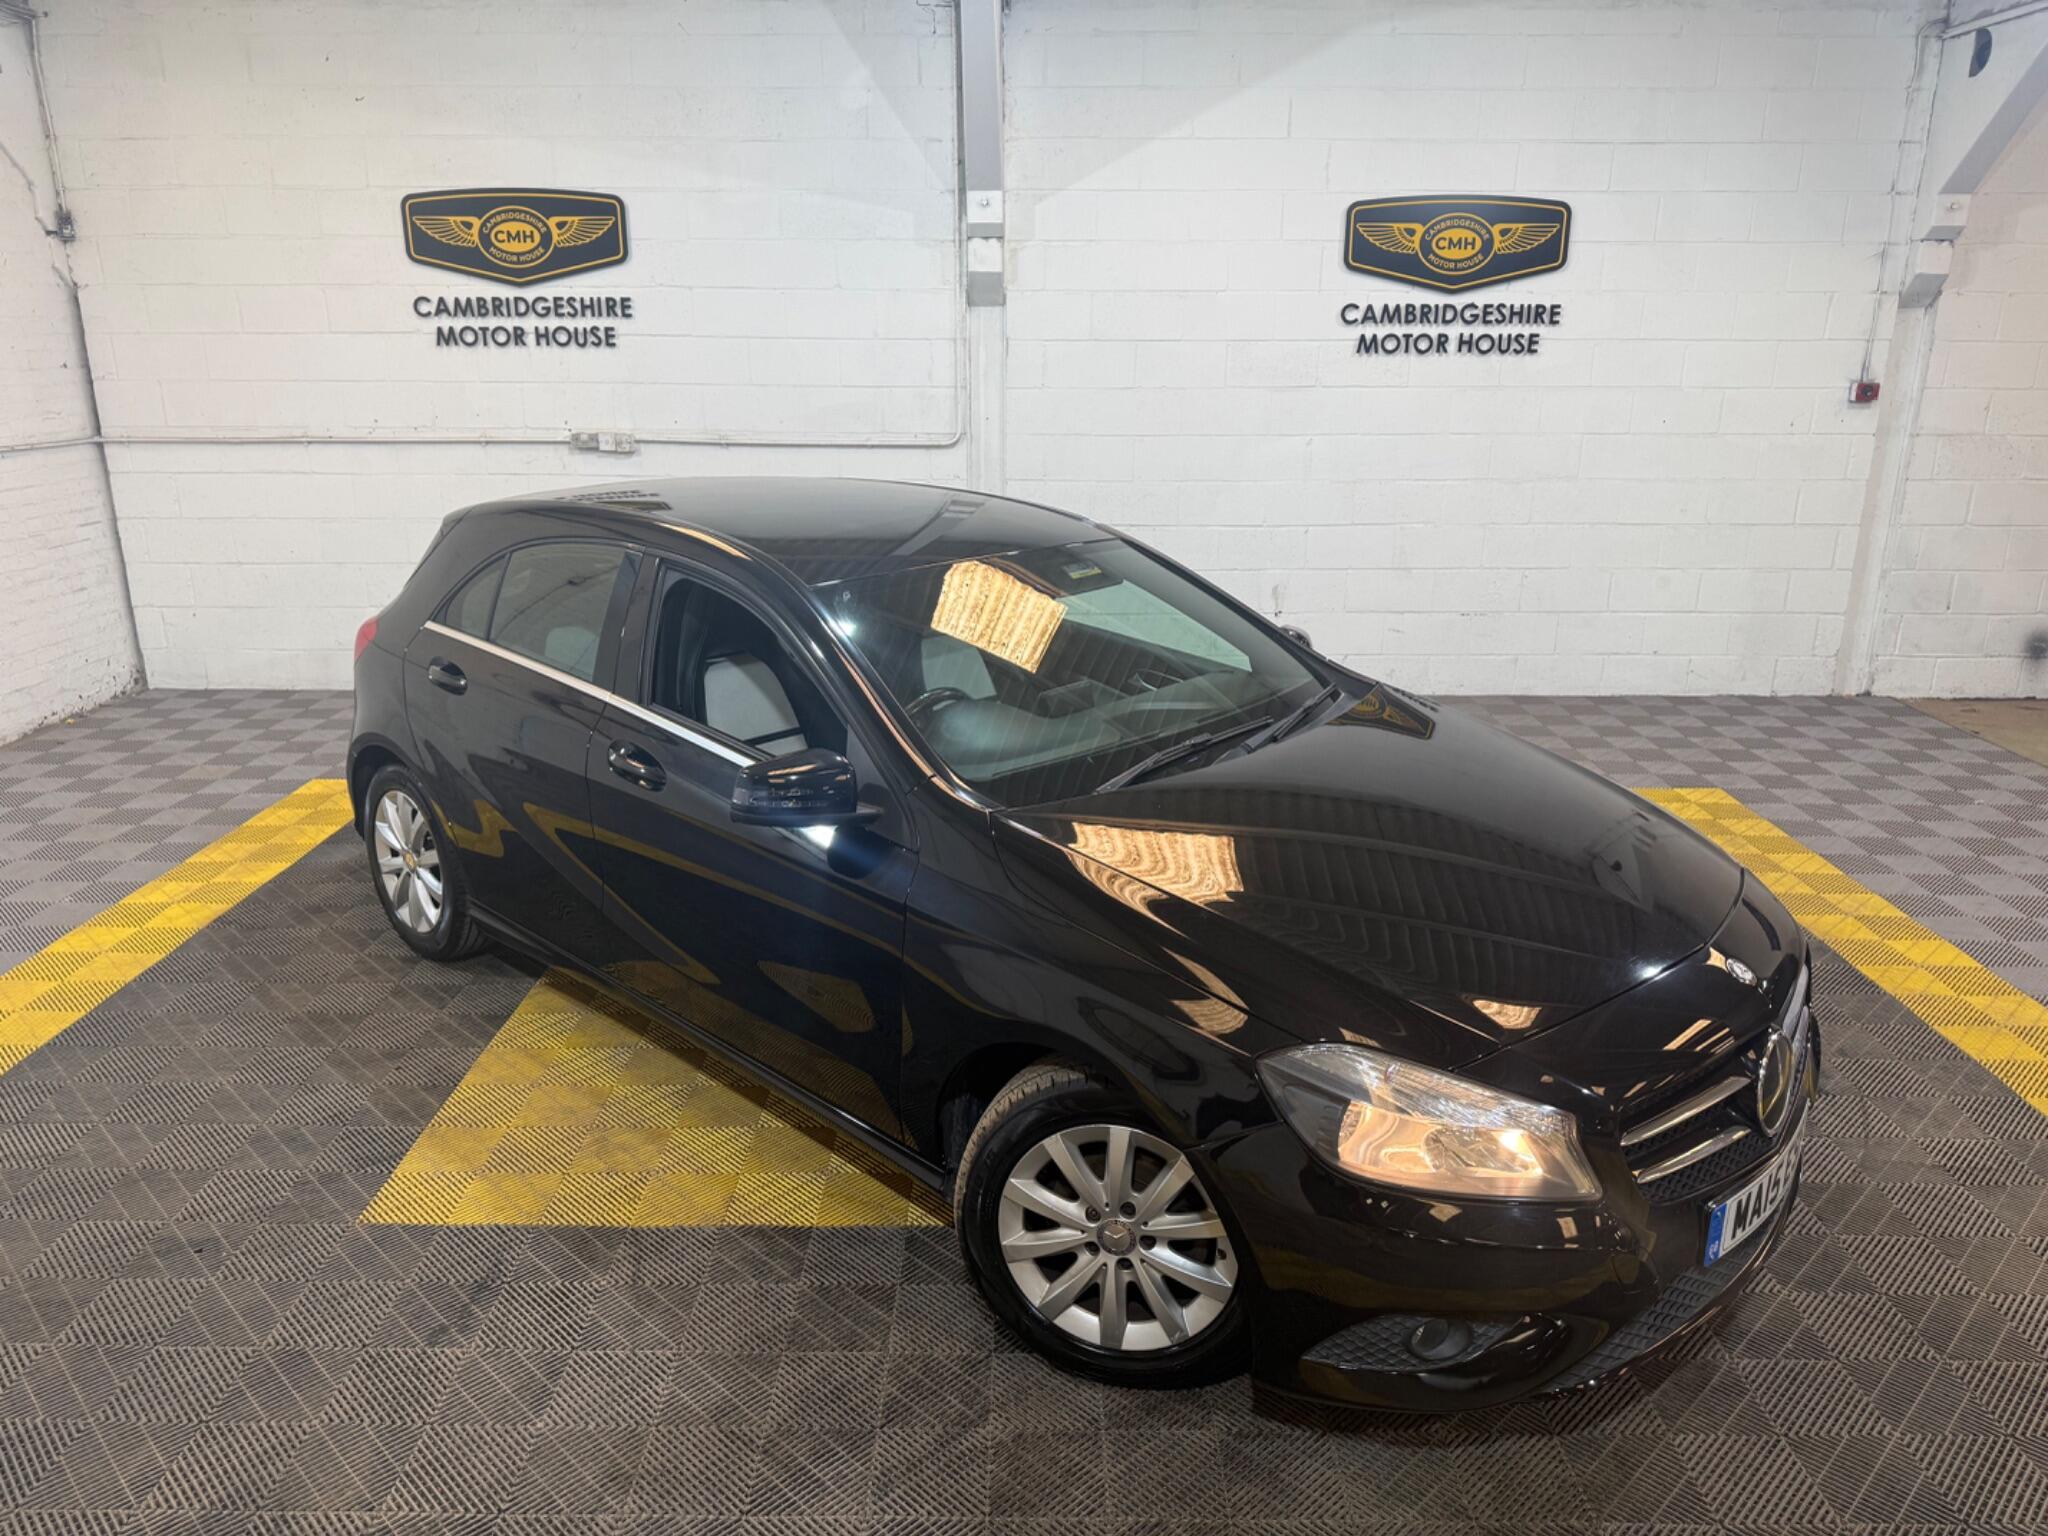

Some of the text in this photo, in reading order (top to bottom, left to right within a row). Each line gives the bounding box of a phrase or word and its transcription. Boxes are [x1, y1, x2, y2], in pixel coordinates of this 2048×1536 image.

[482, 211, 547, 234] CAMBRIDGESHIRE
[1425, 218, 1490, 241] CAMBRIDGESHIRE
[494, 229, 535, 243] CMH
[1435, 236, 1477, 250] CMH
[489, 246, 545, 262] MOTOR HOUSE
[1427, 252, 1485, 270] MOTOR HOUSE
[413, 296, 633, 318] CAMBRIDGESHIRE
[1340, 303, 1562, 325] CAMBRIDGESHIRE
[435, 326, 617, 348] MOTOR HOUSE
[1356, 333, 1540, 354] MOTOR HOUSE
